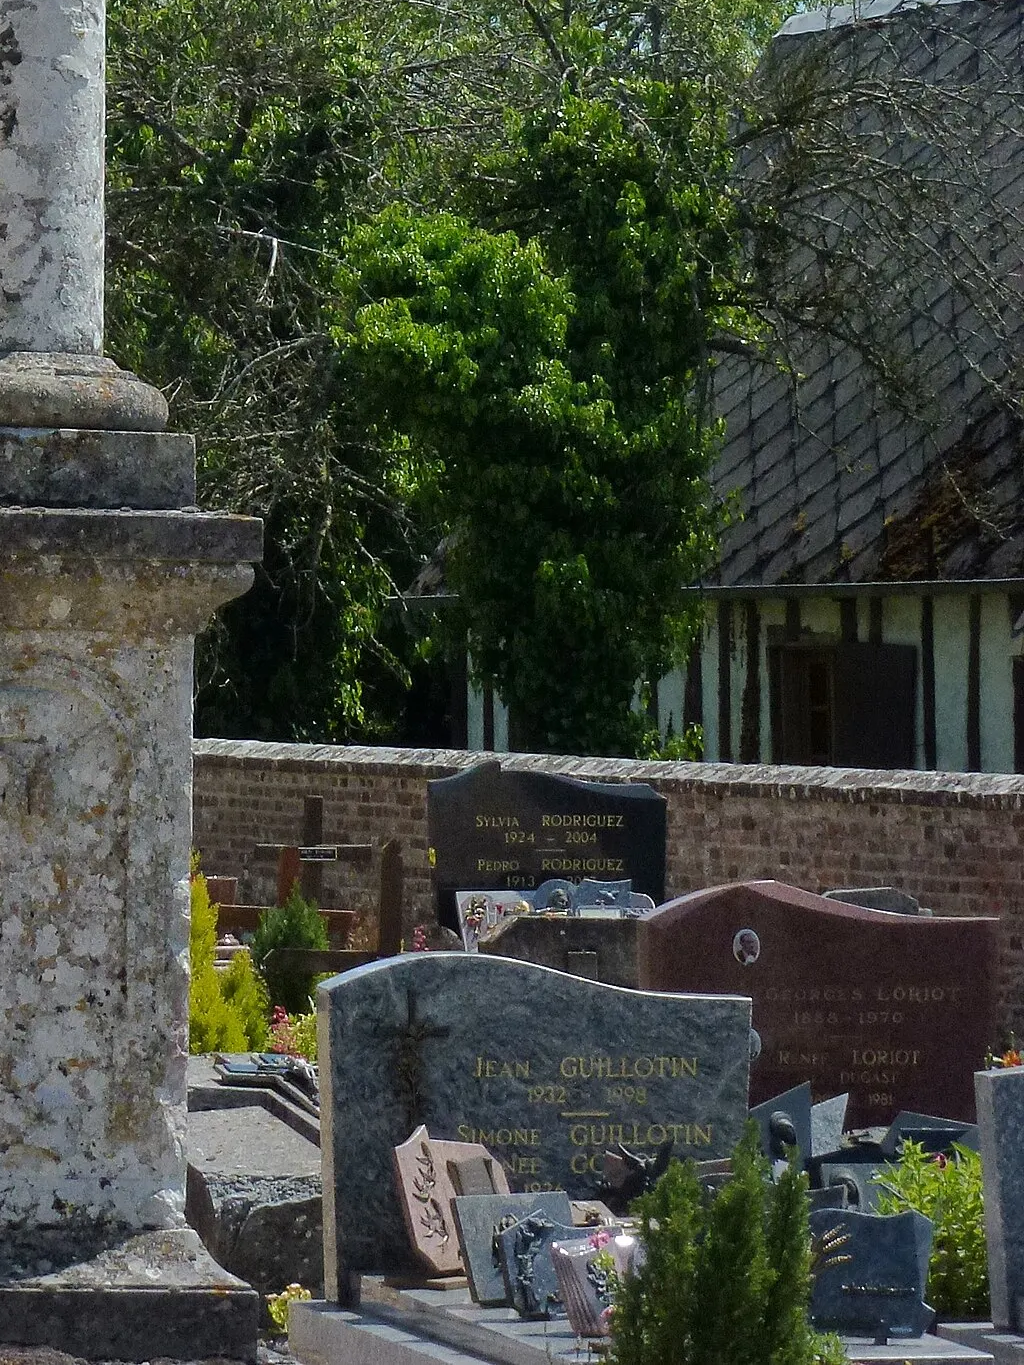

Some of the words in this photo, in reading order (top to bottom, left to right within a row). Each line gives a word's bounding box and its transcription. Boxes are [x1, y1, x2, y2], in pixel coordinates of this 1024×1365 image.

[476, 815, 520, 827] SYLVIA
[542, 815, 624, 827] RODRIGUEZ
[504, 832, 535, 843] 1924
[565, 831, 597, 843] 2004
[477, 859, 520, 871] PEDRO
[541, 859, 624, 871] RODRIGUEZ
[765, 987, 863, 1001] GEORGES
[878, 987, 963, 1003] LORIOT
[858, 1011, 904, 1024] 1970
[852, 1049, 921, 1065] LORIOT
[473, 1057, 530, 1078] JEAN
[560, 1057, 699, 1078] GUILLOTIN
[527, 1086, 567, 1104] 1932
[458, 1125, 541, 1145] SIMONE
[570, 1124, 714, 1146] GUILLOTIN
